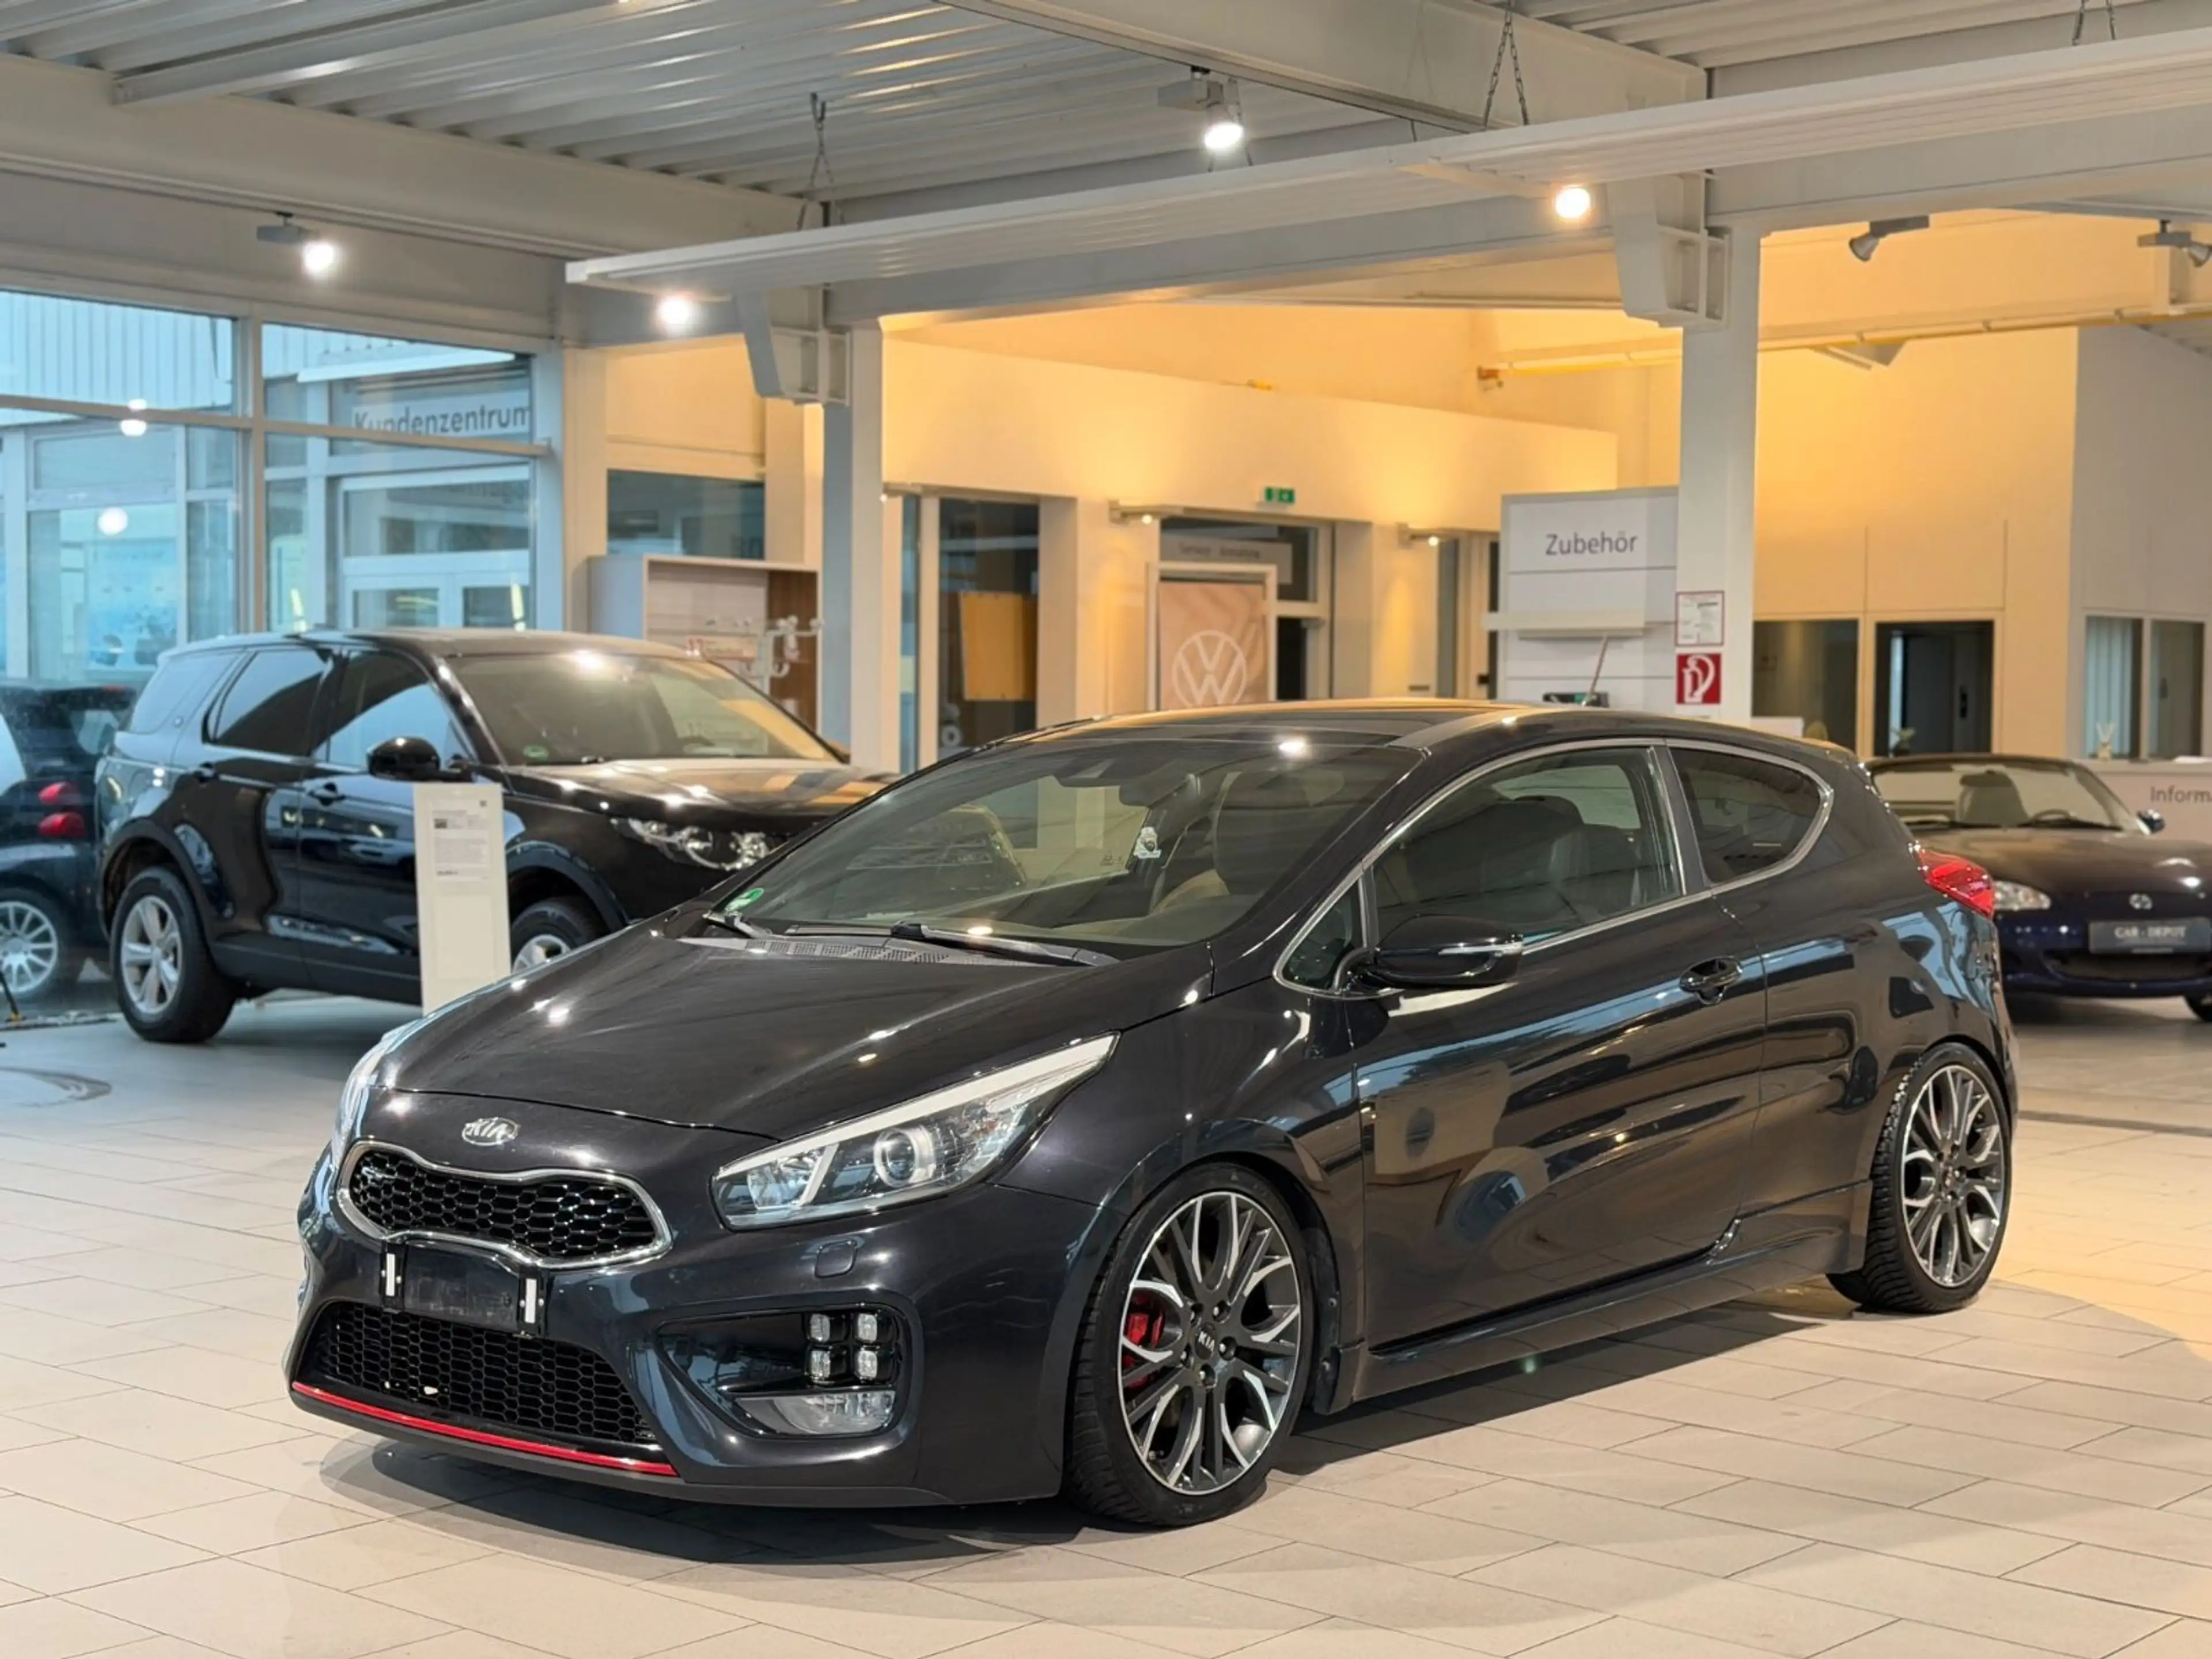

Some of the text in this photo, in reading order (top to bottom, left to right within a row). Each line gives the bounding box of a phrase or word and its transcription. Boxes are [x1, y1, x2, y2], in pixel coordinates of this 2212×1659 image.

[1546, 530, 1638, 556] Zubehör
[2150, 785, 2212, 803] Inform
[464, 1118, 516, 1142] KIA
[1198, 1331, 1215, 1352] KIA
